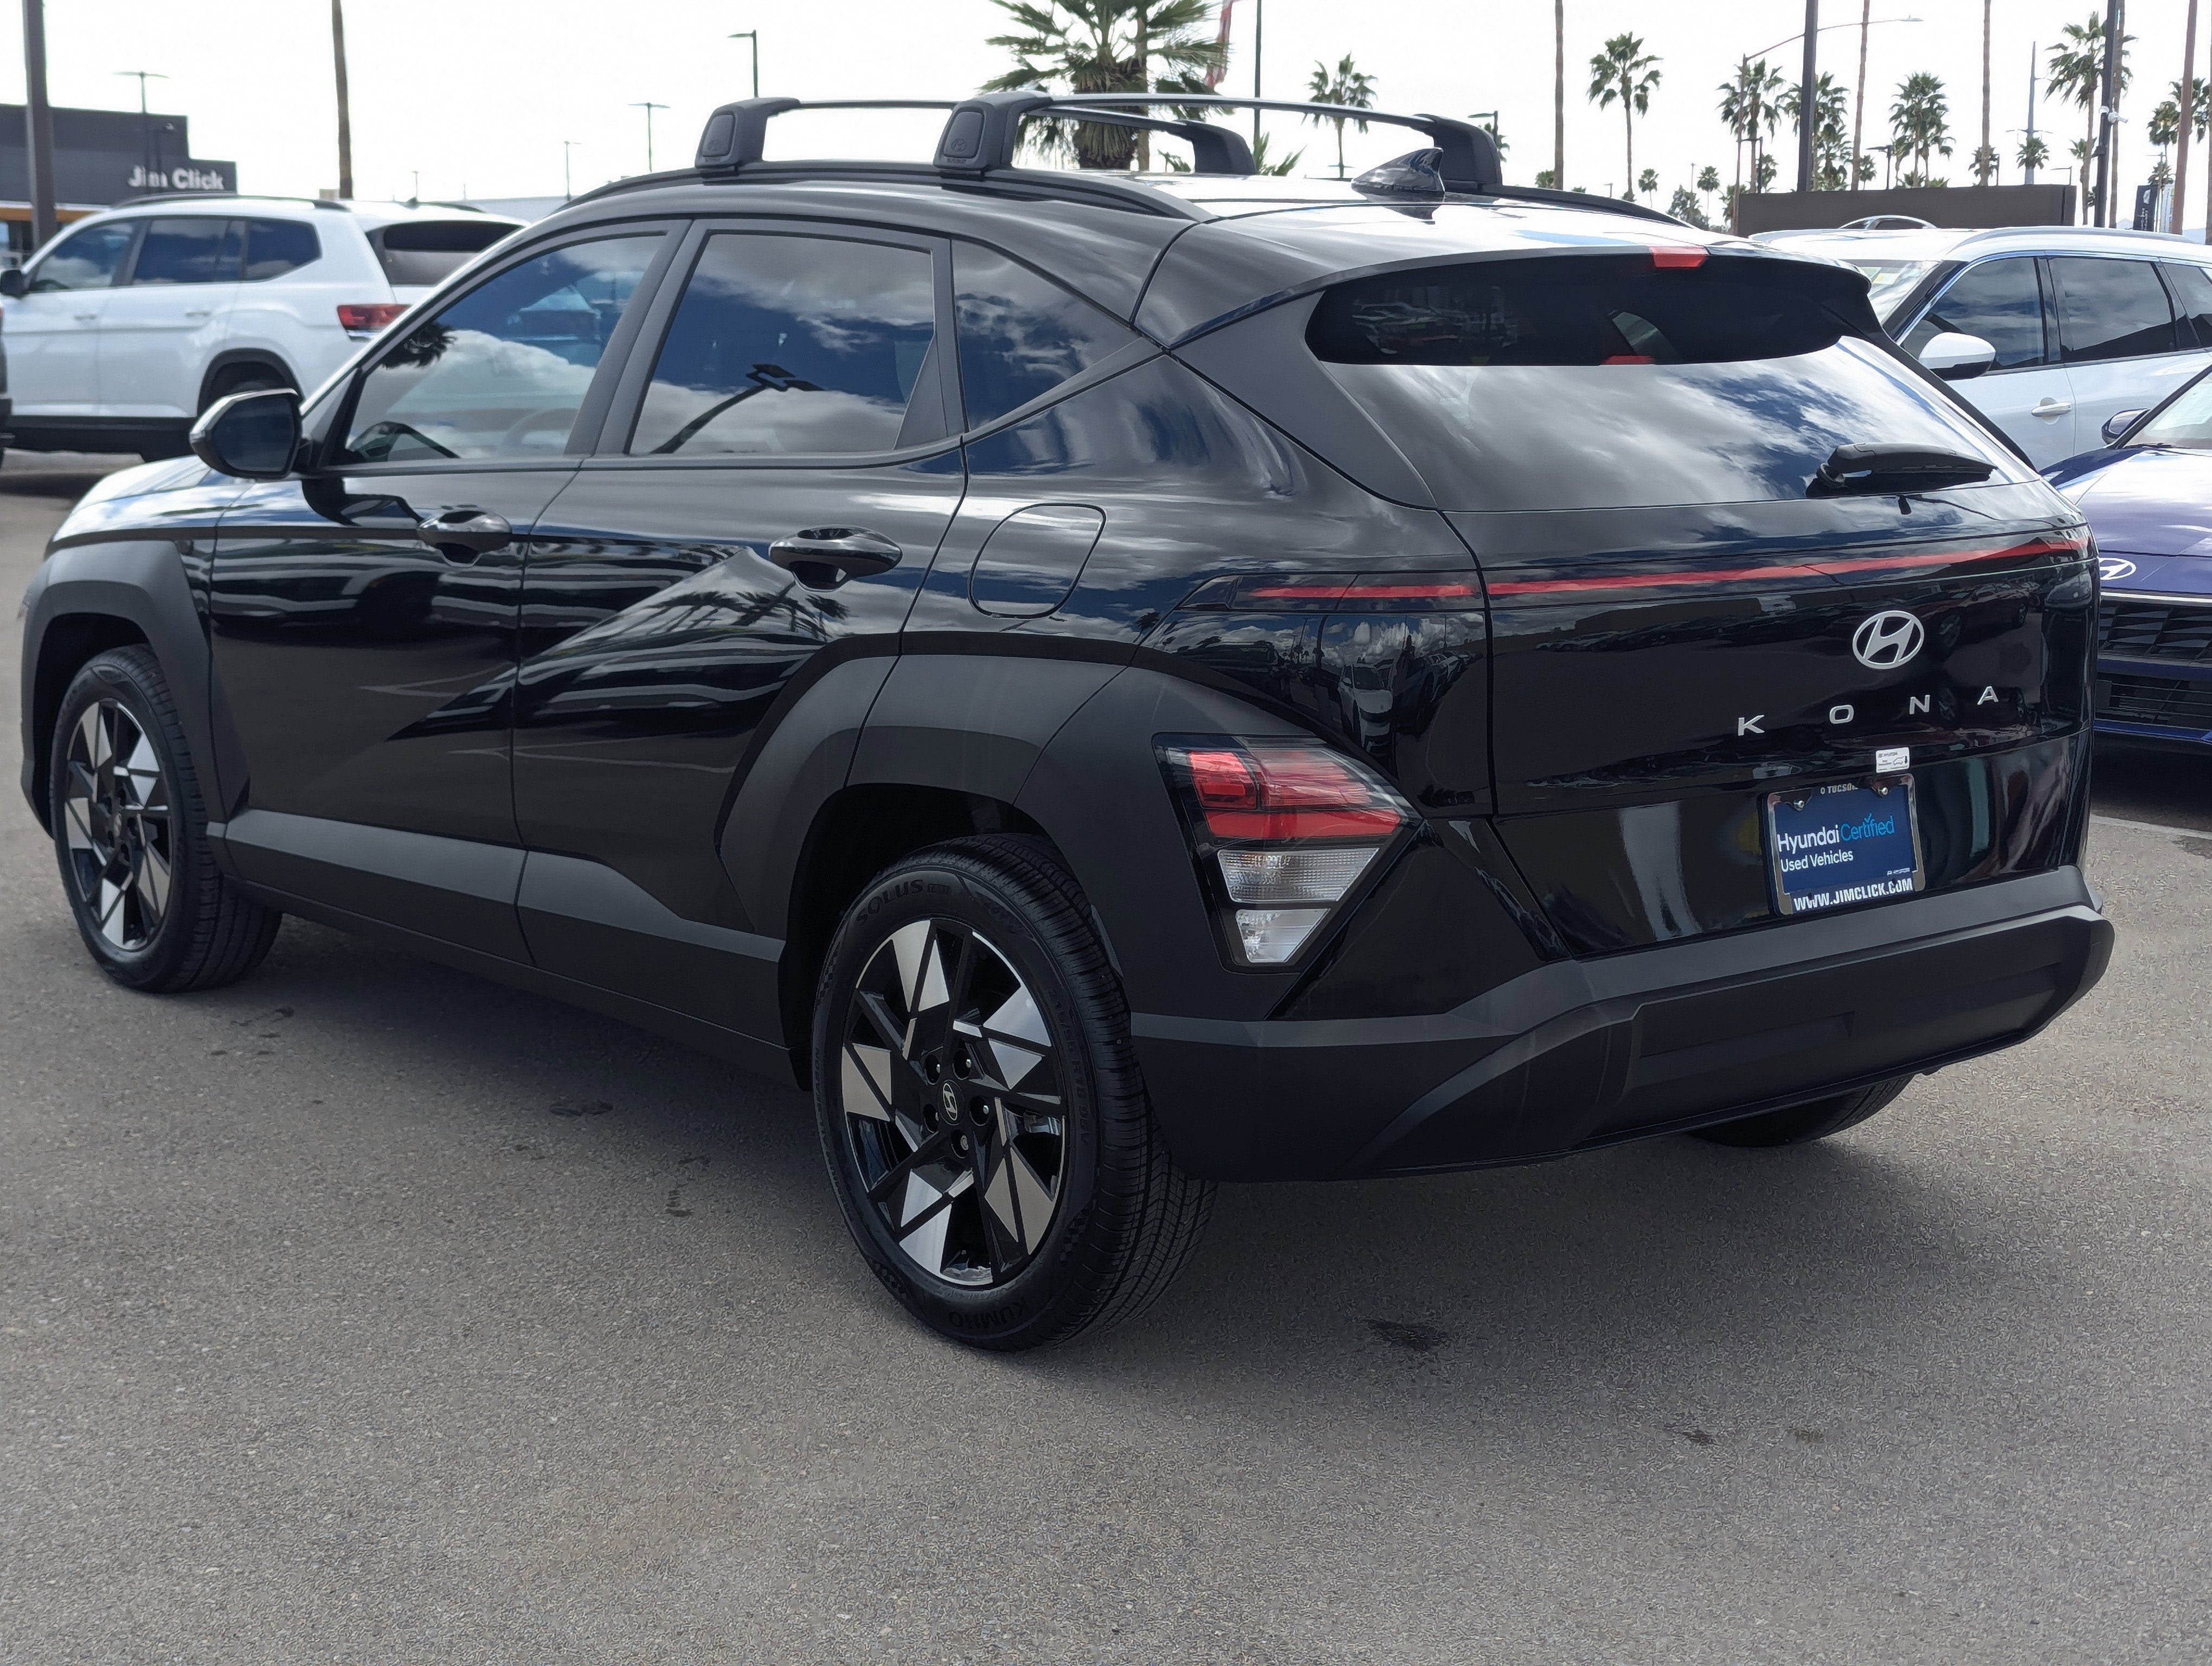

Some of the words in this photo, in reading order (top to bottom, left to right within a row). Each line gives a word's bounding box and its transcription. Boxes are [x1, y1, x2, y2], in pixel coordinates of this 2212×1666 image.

[127, 165, 168, 187] Jim
[172, 167, 224, 190] Click
[1738, 686, 1999, 736] KONA
[1777, 824, 1840, 855] Hyundai
[1840, 813, 1895, 841] Certified
[1780, 855, 1809, 872] Used
[1809, 849, 1854, 867] Vehicles
[856, 879, 924, 924] SOLUS
[1793, 877, 1913, 911] WWW.JIMCLICK.COM
[948, 1296, 1028, 1329] KUMHO
